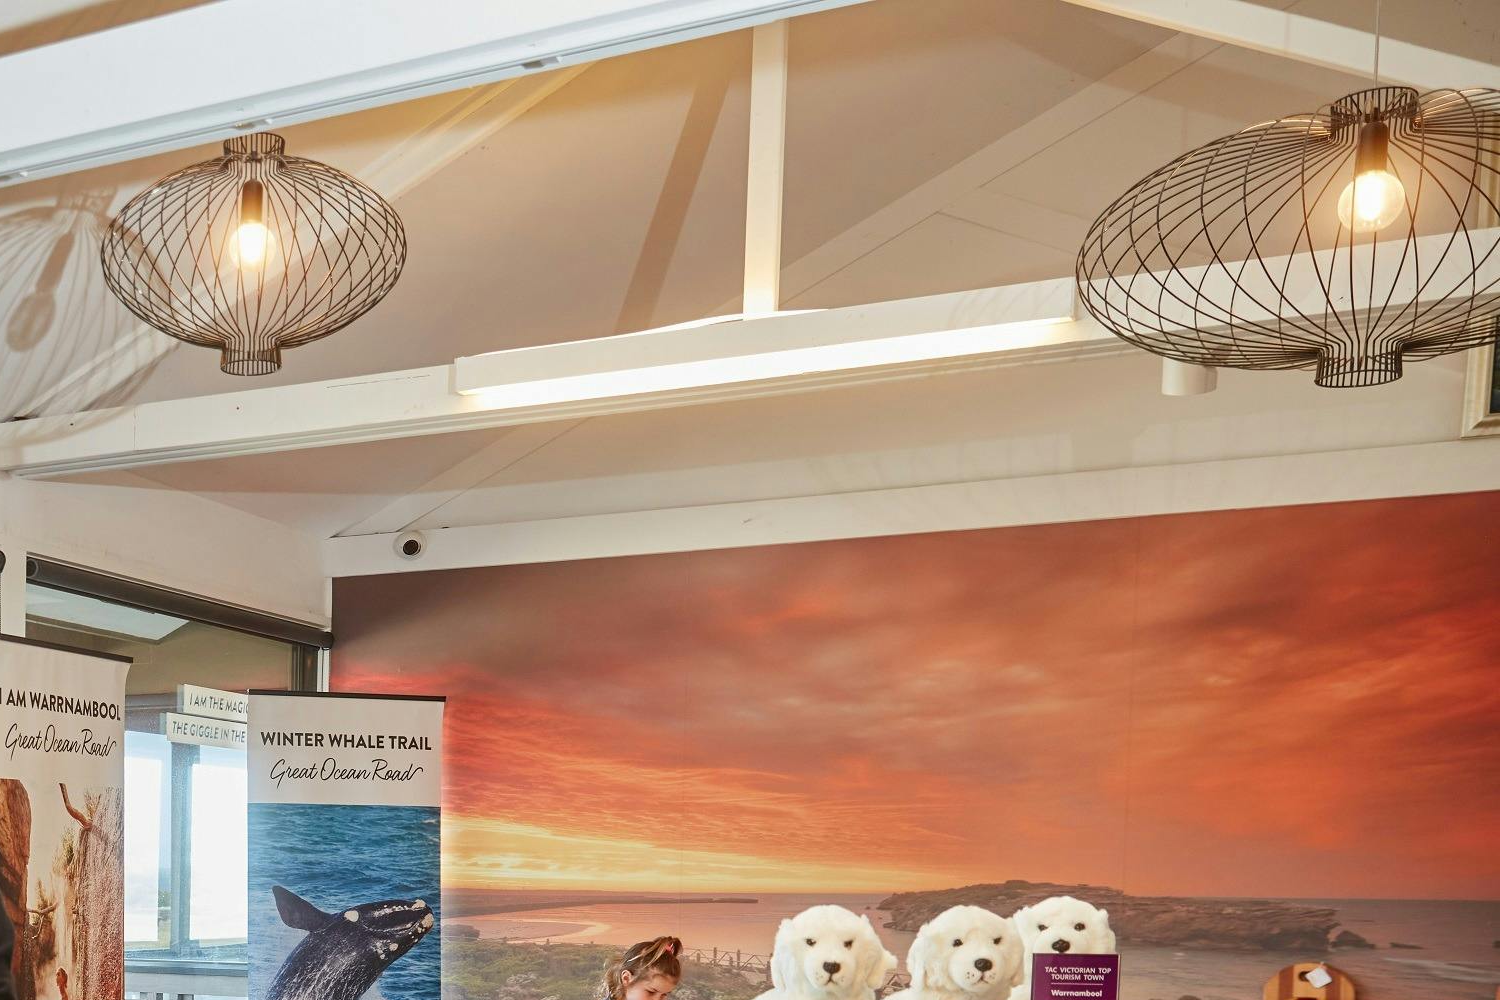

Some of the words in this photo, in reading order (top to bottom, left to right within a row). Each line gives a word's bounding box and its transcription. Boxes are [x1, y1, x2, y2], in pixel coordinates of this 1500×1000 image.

[6, 689, 27, 708] AM
[30, 692, 121, 721] WARRNAMBOOL
[189, 693, 193, 706] I
[194, 695, 207, 708] AM
[210, 696, 224, 710] THE
[4, 723, 43, 760] Great
[43, 724, 82, 753] Ocean
[80, 728, 117, 758] Road
[172, 721, 188, 735] THE
[190, 723, 219, 740] GIGGLE
[220, 727, 230, 740] IN
[231, 729, 246, 743] THE
[260, 731, 324, 747] WINTER
[328, 733, 385, 749] WHALE
[388, 736, 432, 751] TRAIL
[270, 758, 318, 789] Great
[320, 757, 371, 781] Ocean
[371, 758, 424, 782] Road
[1051, 989, 1102, 997] Warrnambool
